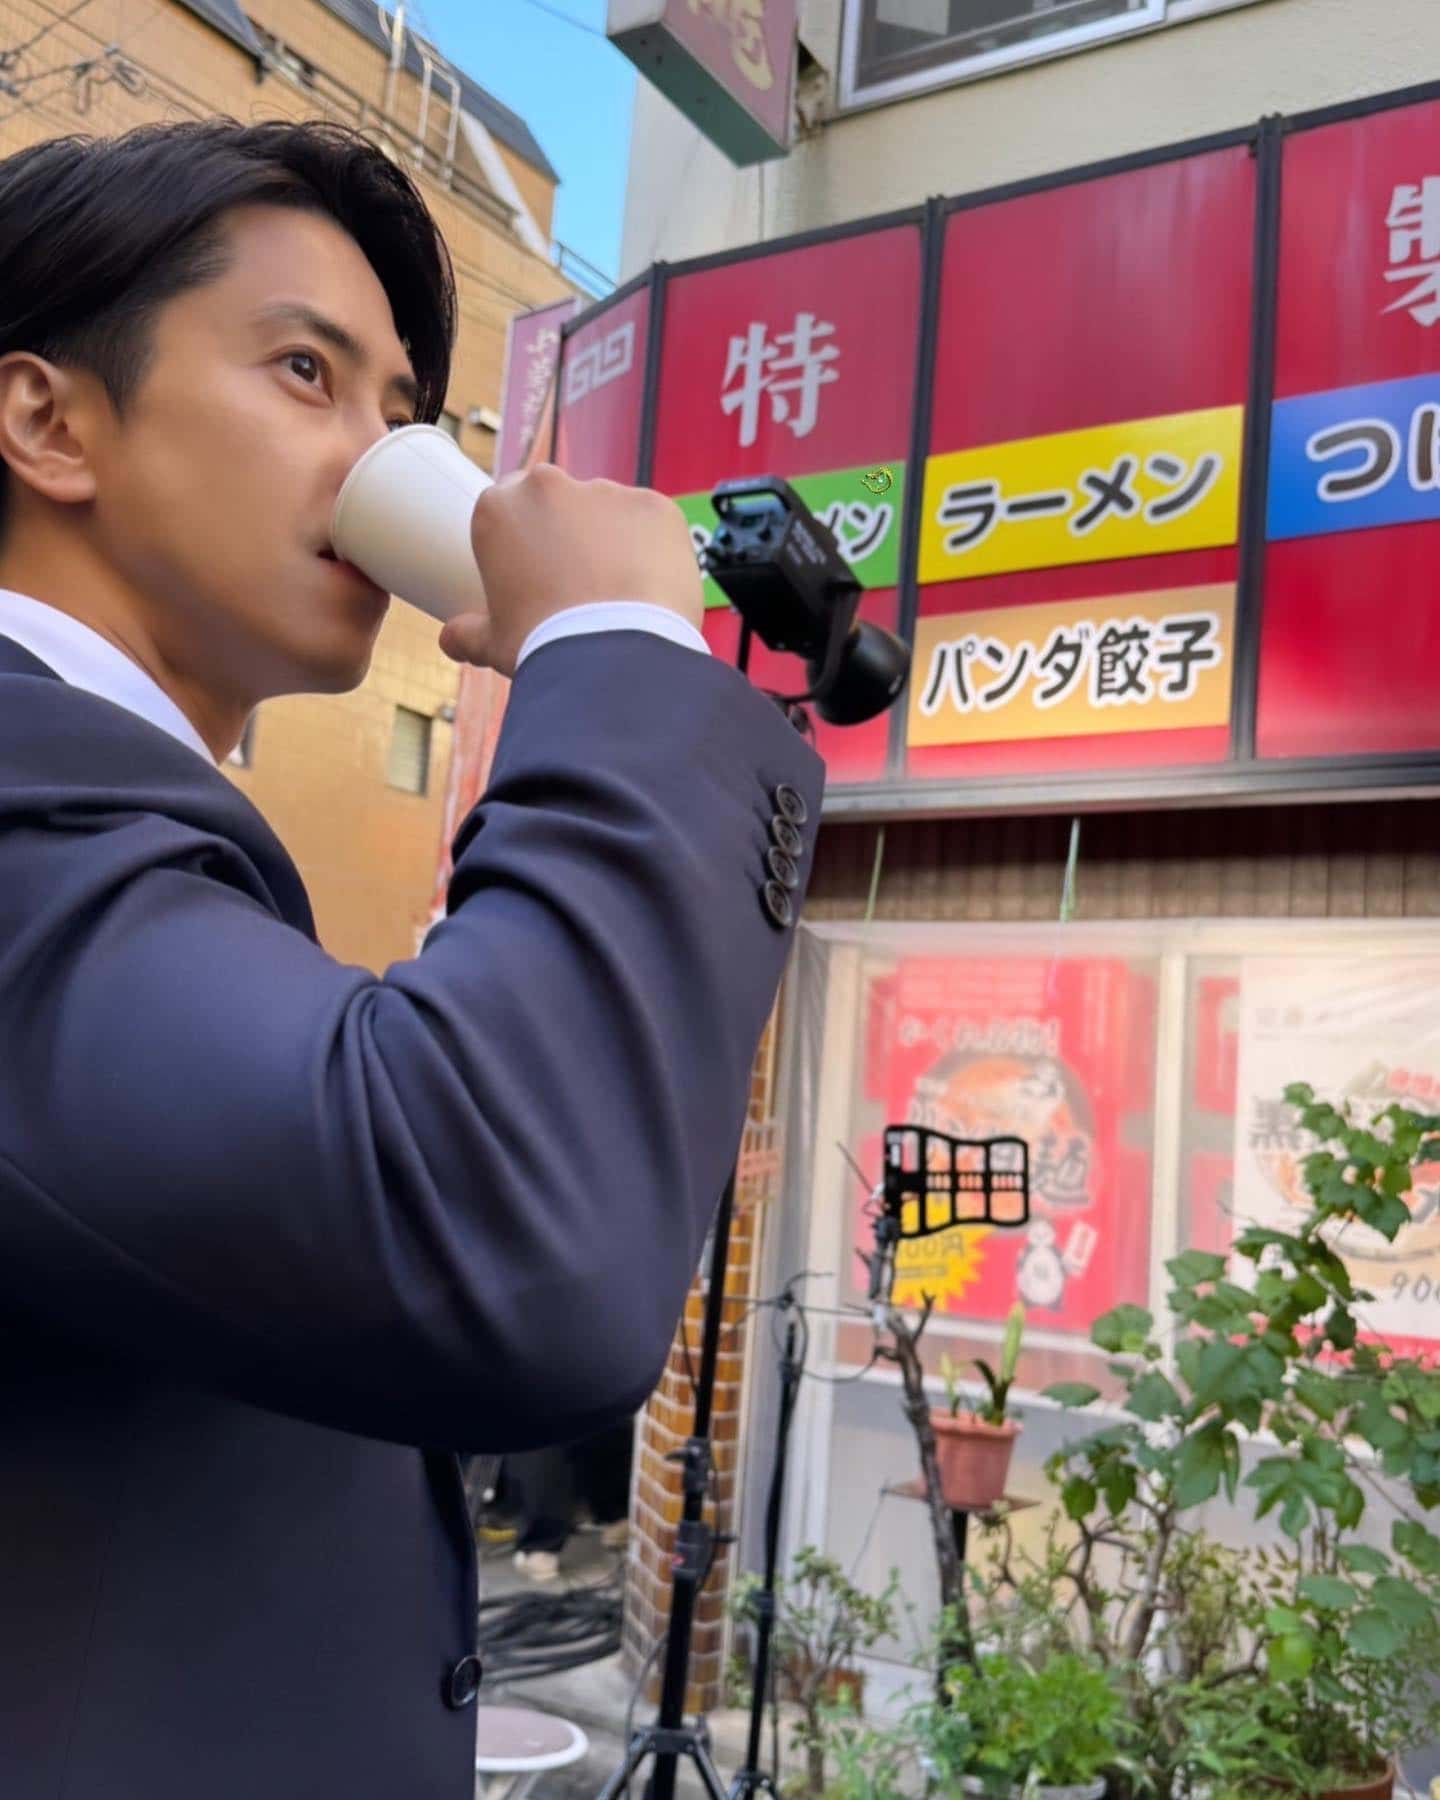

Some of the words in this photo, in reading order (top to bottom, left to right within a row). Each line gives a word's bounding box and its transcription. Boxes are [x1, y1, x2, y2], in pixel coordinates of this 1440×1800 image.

[721, 311, 841, 448] 特
[938, 453, 1222, 553] ラーメン
[922, 612, 1219, 716] パンダ餃子
[1391, 1272, 1440, 1303] 90
